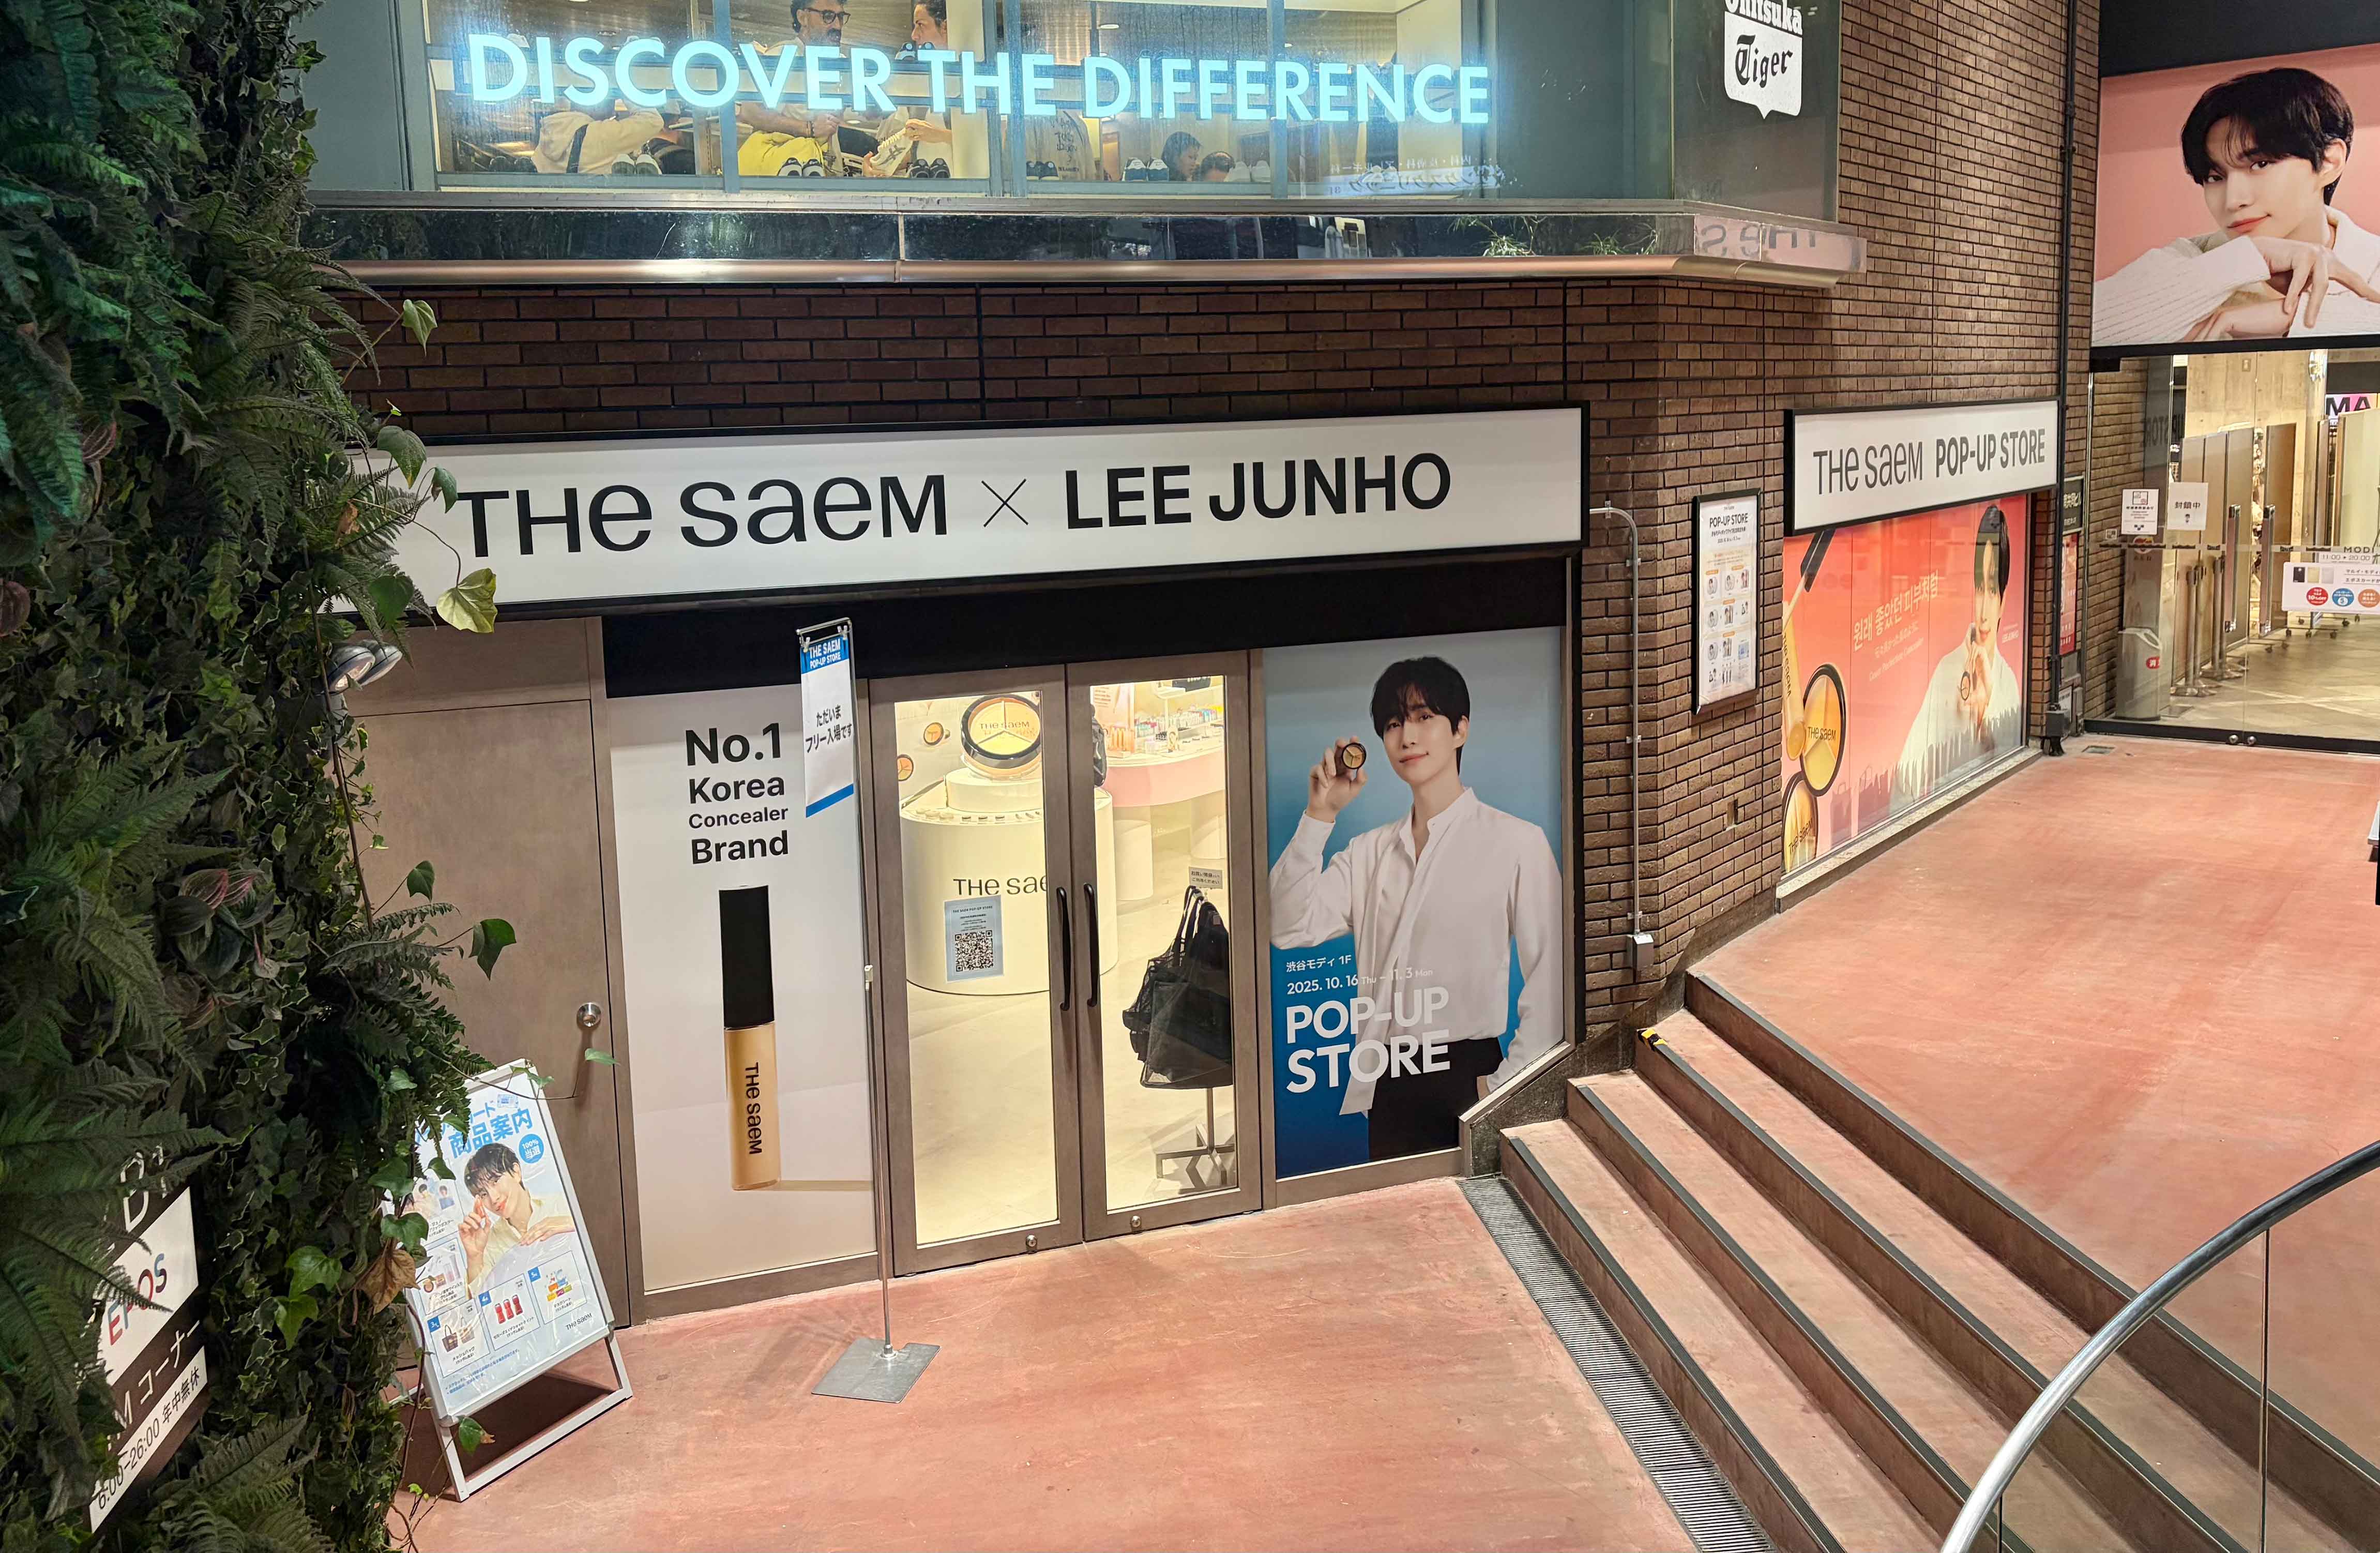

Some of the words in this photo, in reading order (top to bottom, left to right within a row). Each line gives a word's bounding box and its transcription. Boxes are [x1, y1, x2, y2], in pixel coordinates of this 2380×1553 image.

[1735, 35, 1793, 88] Tiger
[469, 33, 898, 113] DISCOVER
[917, 49, 1056, 118] THE
[1083, 56, 1490, 124] DIFFERENCE
[1936, 433, 1997, 478] POP-UP
[2000, 428, 2046, 469] STORE
[1066, 464, 1192, 529] LEE
[1209, 453, 1451, 522] JUNHO
[2175, 501, 2201, 509] 封鎖中
[1709, 515, 1731, 528] POP-UP
[1731, 512, 1748, 525] STORE
[1854, 612, 1873, 652] 원래
[1875, 592, 1902, 637] 좋았던
[1904, 568, 1939, 613] 피부처럼
[809, 644, 822, 659] THE
[823, 638, 841, 654] SAEM
[810, 657, 826, 669] POP-UP
[827, 652, 841, 663] STORE
[816, 705, 841, 728] ただいま
[686, 723, 781, 766] No.1
[806, 722, 853, 753] フリー入場です
[689, 776, 784, 804] Korea
[689, 807, 789, 829] Concealer
[691, 830, 789, 865] Brand
[1286, 957, 1336, 973] 渋谷モディ
[1338, 955, 1352, 965] 1F
[1286, 979, 1323, 995] 2025.
[1325, 976, 1343, 989] 10.
[1346, 974, 1359, 987] 16
[1360, 976, 1377, 985] Thu
[1415, 968, 1433, 978] Mon
[1286, 987, 1449, 1044] POP-UP
[1286, 1029, 1451, 1093] STORE
[448, 1108, 533, 1159] 商品案内
[522, 1138, 539, 1149] 100%
[524, 1145, 541, 1159] 当選
[162, 1365, 201, 1425] 年中無休
